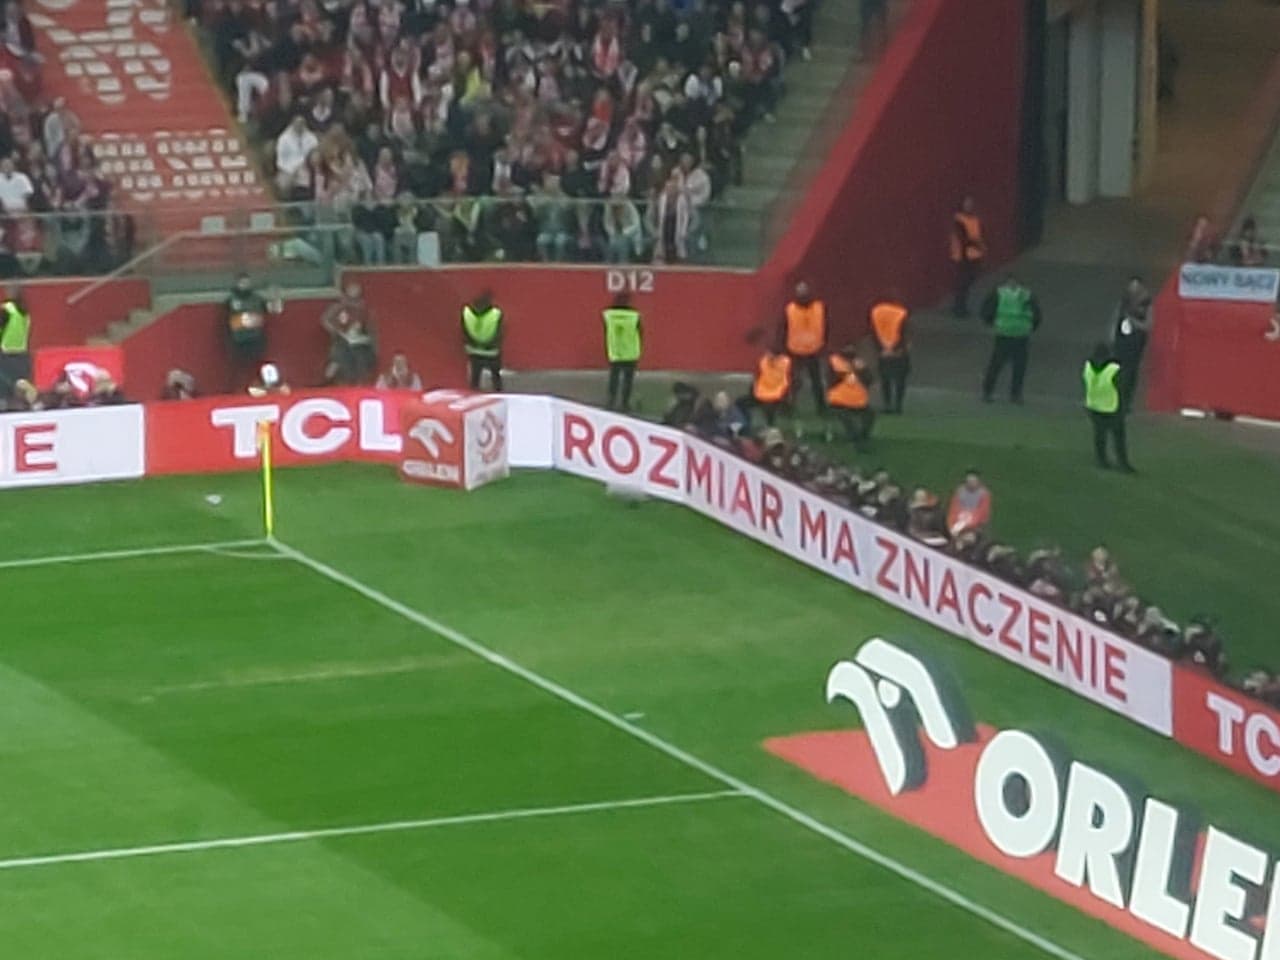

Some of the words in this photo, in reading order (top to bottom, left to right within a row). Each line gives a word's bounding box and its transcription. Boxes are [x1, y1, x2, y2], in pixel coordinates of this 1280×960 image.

[608, 270, 654, 292] D12
[211, 398, 403, 458] TCL
[563, 413, 784, 539] ROZMIAR
[800, 508, 861, 576] MA
[875, 535, 1129, 703] ZNACZENIE
